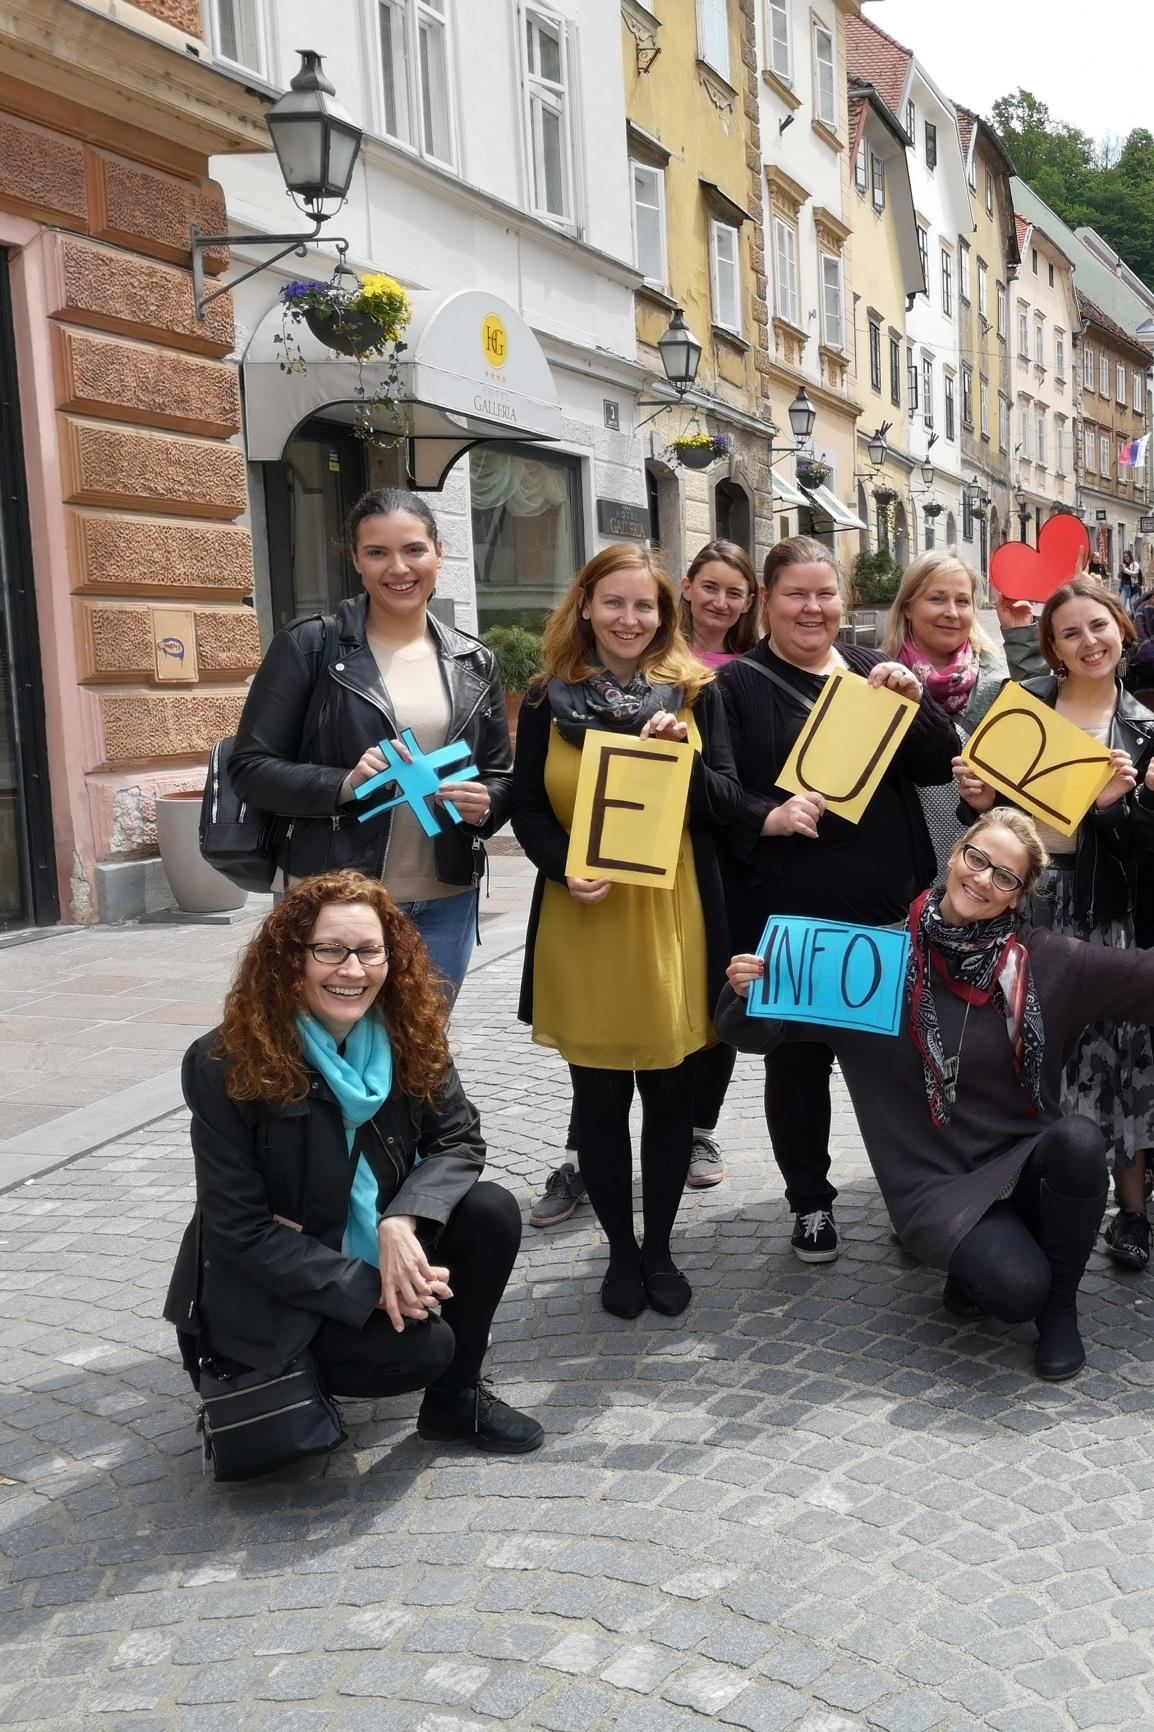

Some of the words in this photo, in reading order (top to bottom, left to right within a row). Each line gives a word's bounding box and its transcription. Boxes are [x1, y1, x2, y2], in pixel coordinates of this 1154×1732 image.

[473, 394, 517, 422] GALLERIA
[795, 675, 908, 804] U
[968, 708, 1112, 826] R
[586, 746, 679, 876] E
[760, 924, 882, 1009] INFO
